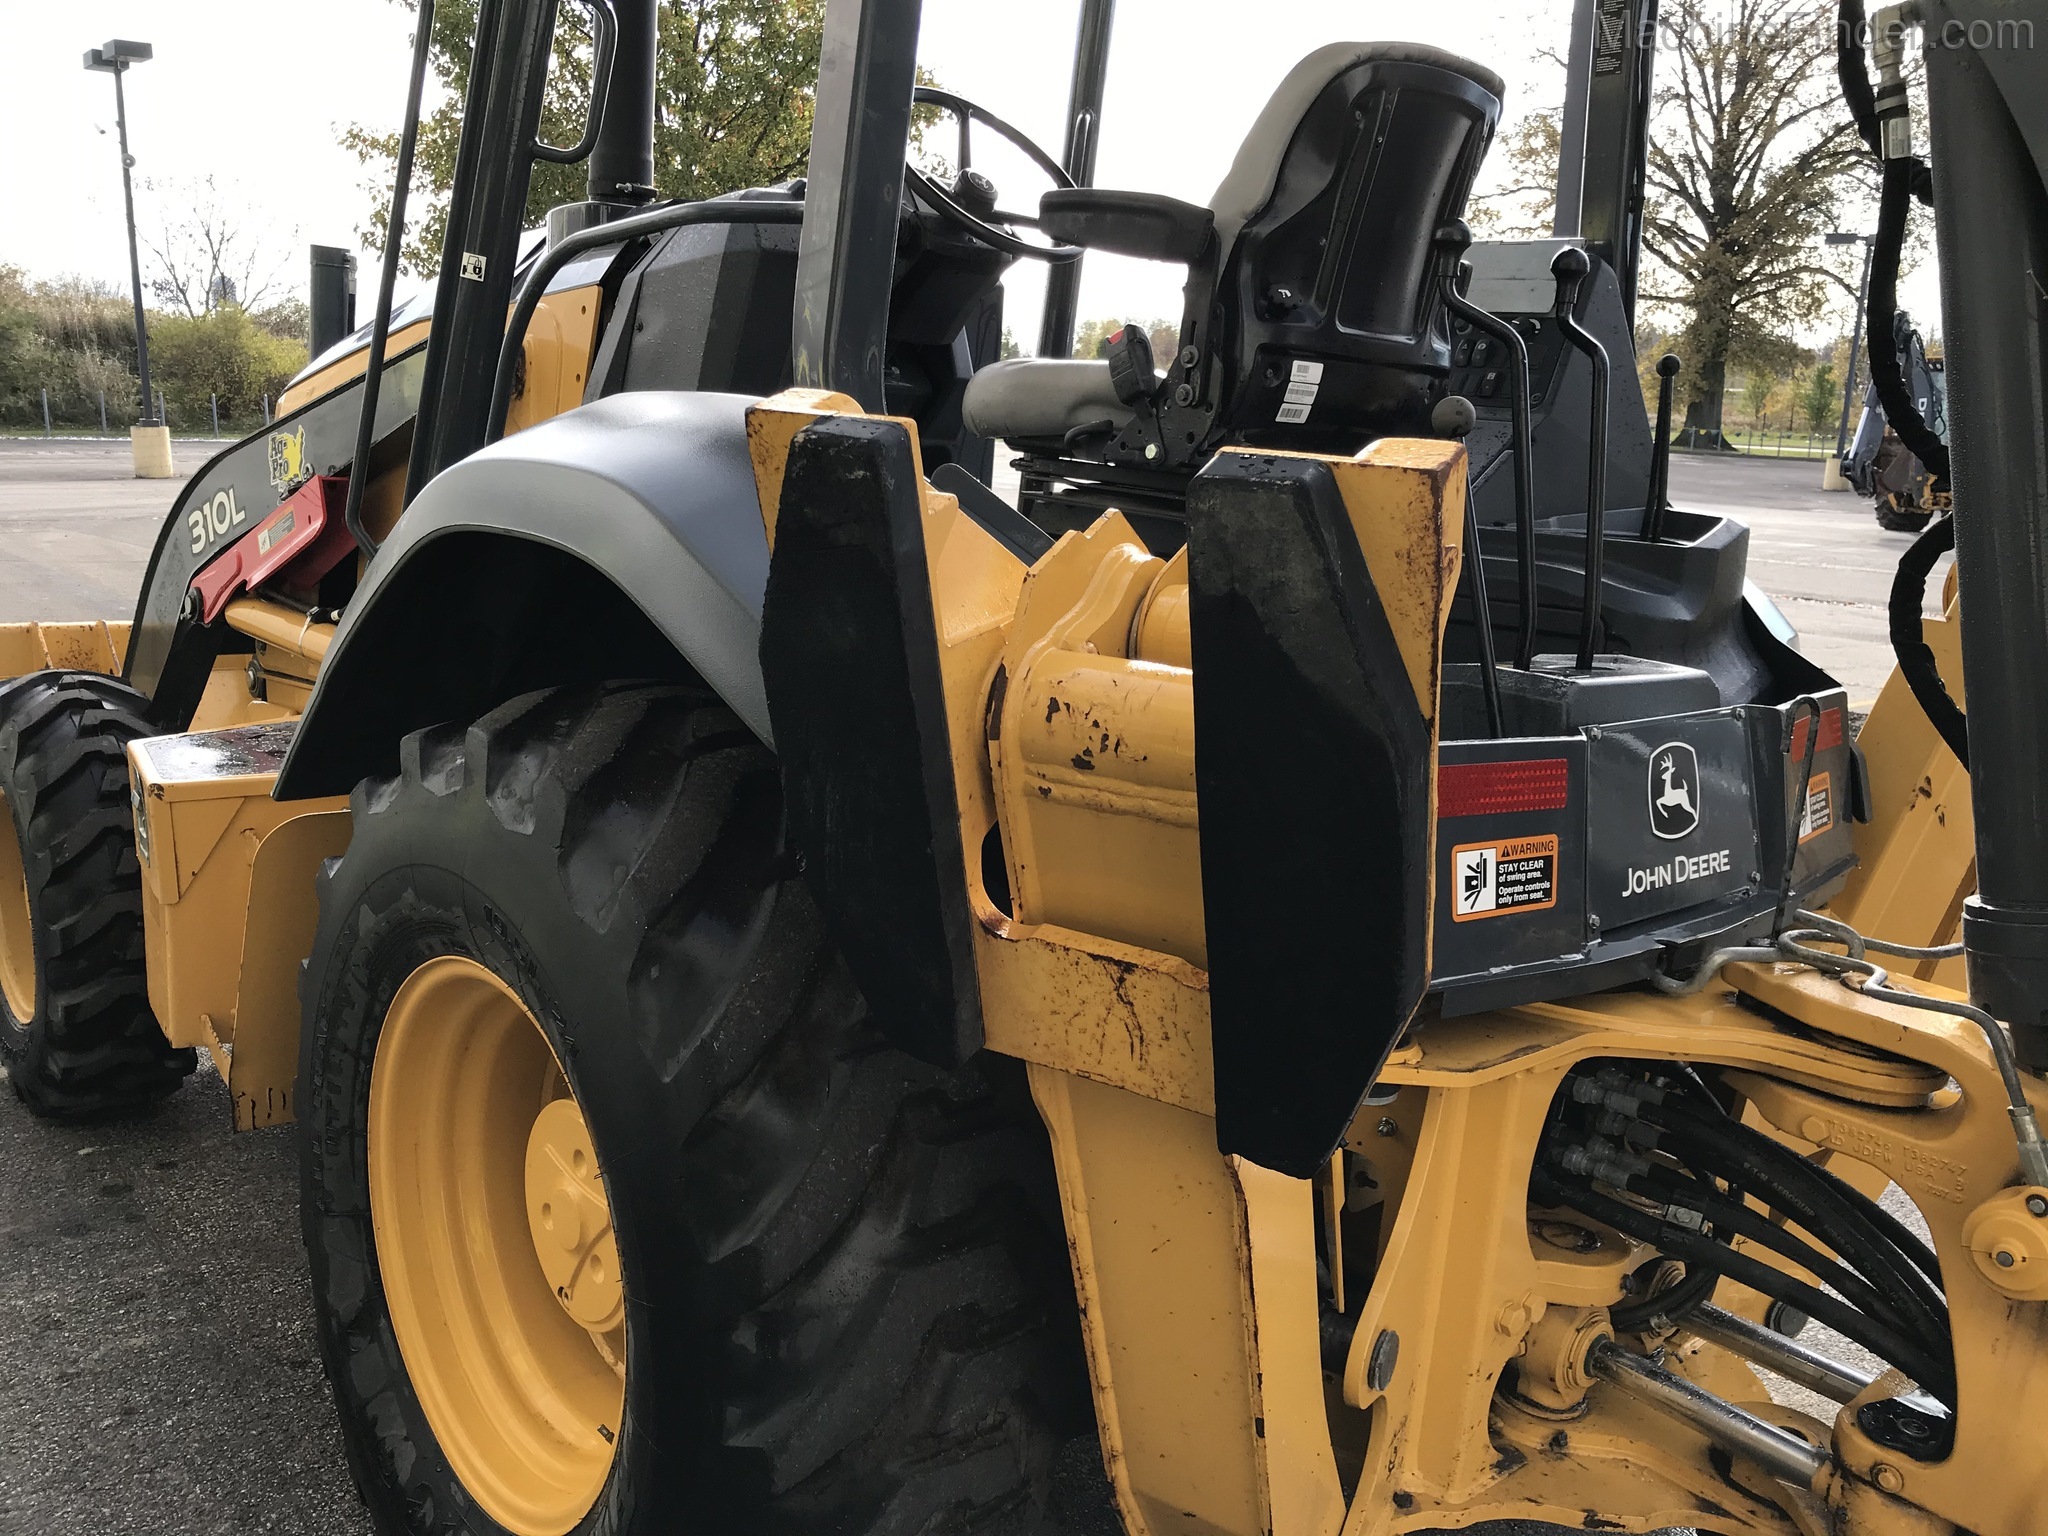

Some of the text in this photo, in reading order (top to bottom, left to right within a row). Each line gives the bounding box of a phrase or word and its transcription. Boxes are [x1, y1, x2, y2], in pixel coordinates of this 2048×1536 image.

[187, 487, 246, 554] 310L
[1510, 840, 1554, 856] WARNING
[1499, 859, 1544, 874] STAY CLEAR
[1621, 850, 1731, 898] JOHN DEERE
[1499, 870, 1542, 883] of swing area.
[1499, 880, 1551, 896] Operate controls
[1499, 890, 1544, 905] only from seat.
